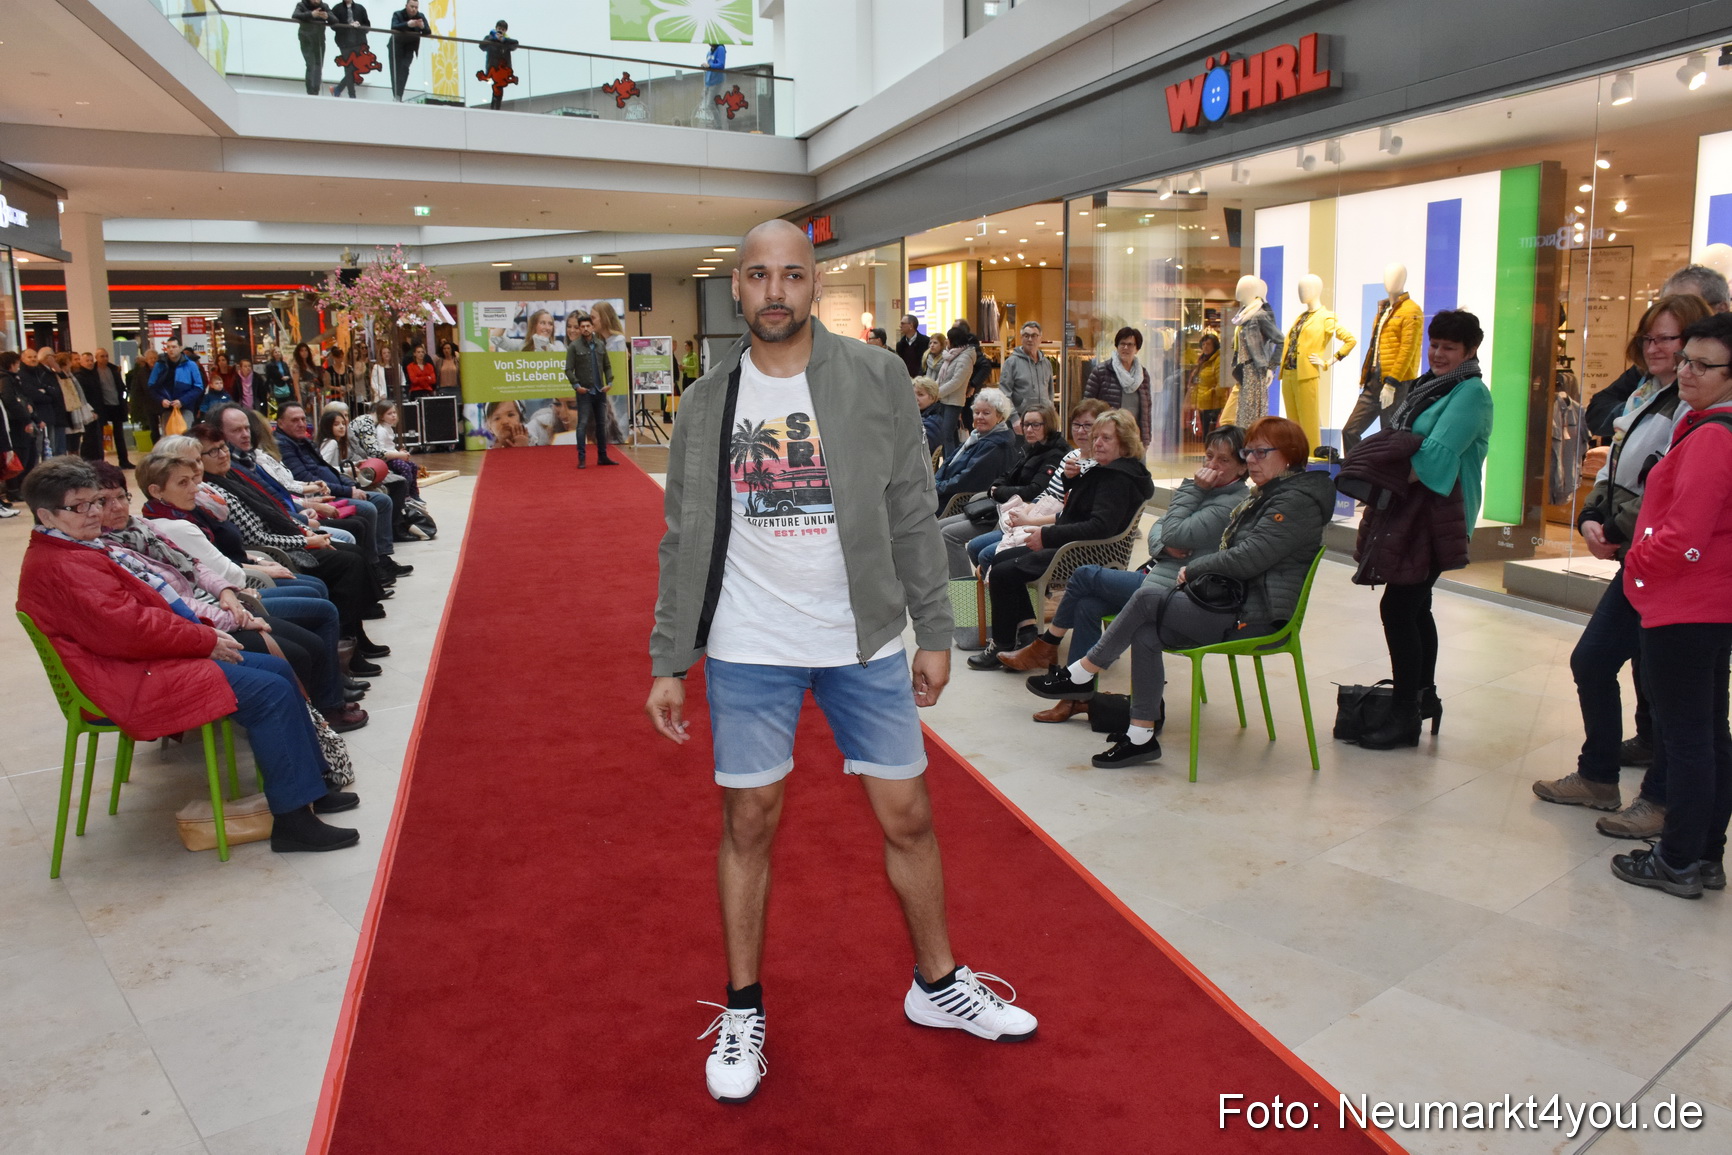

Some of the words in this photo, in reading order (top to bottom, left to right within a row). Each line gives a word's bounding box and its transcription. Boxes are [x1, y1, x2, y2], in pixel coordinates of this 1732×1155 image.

[1165, 32, 1332, 133] WÖHRL
[494, 360, 514, 370] Von
[516, 358, 567, 371] Shopping
[505, 372, 521, 383] bis
[523, 371, 556, 382] Leben
[801, 527, 828, 536] 1990
